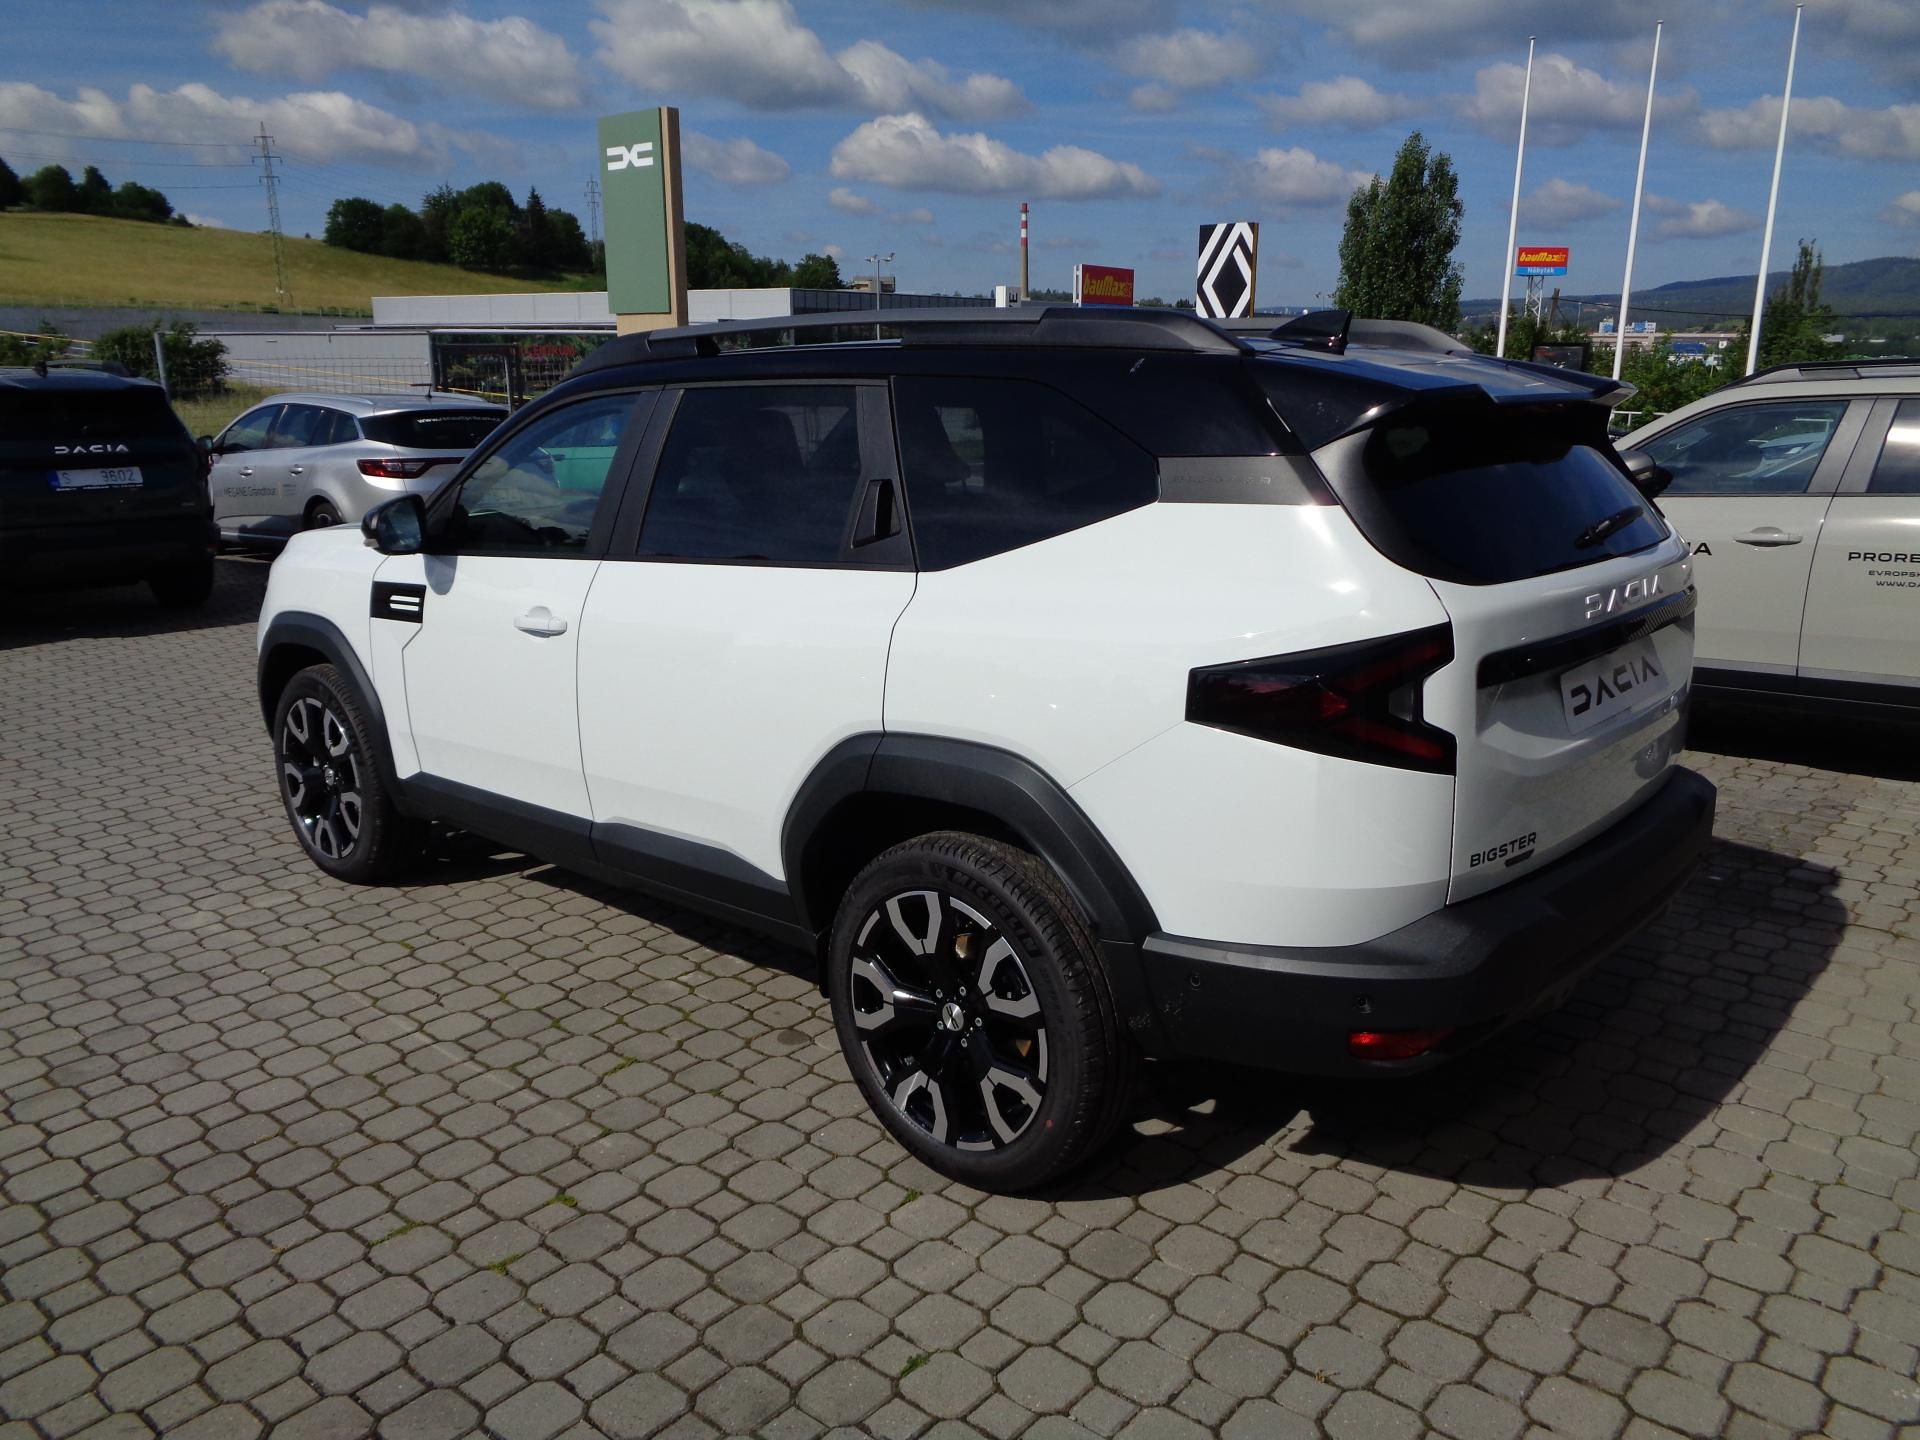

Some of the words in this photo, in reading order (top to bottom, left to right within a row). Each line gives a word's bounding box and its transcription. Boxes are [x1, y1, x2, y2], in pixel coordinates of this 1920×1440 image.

[54, 444, 129, 454] DACIA
[1848, 551, 1920, 563] PRORE
[1585, 574, 1664, 619] DACIA
[1570, 655, 1660, 717] DACIA
[1470, 831, 1537, 868] BIGSTER
